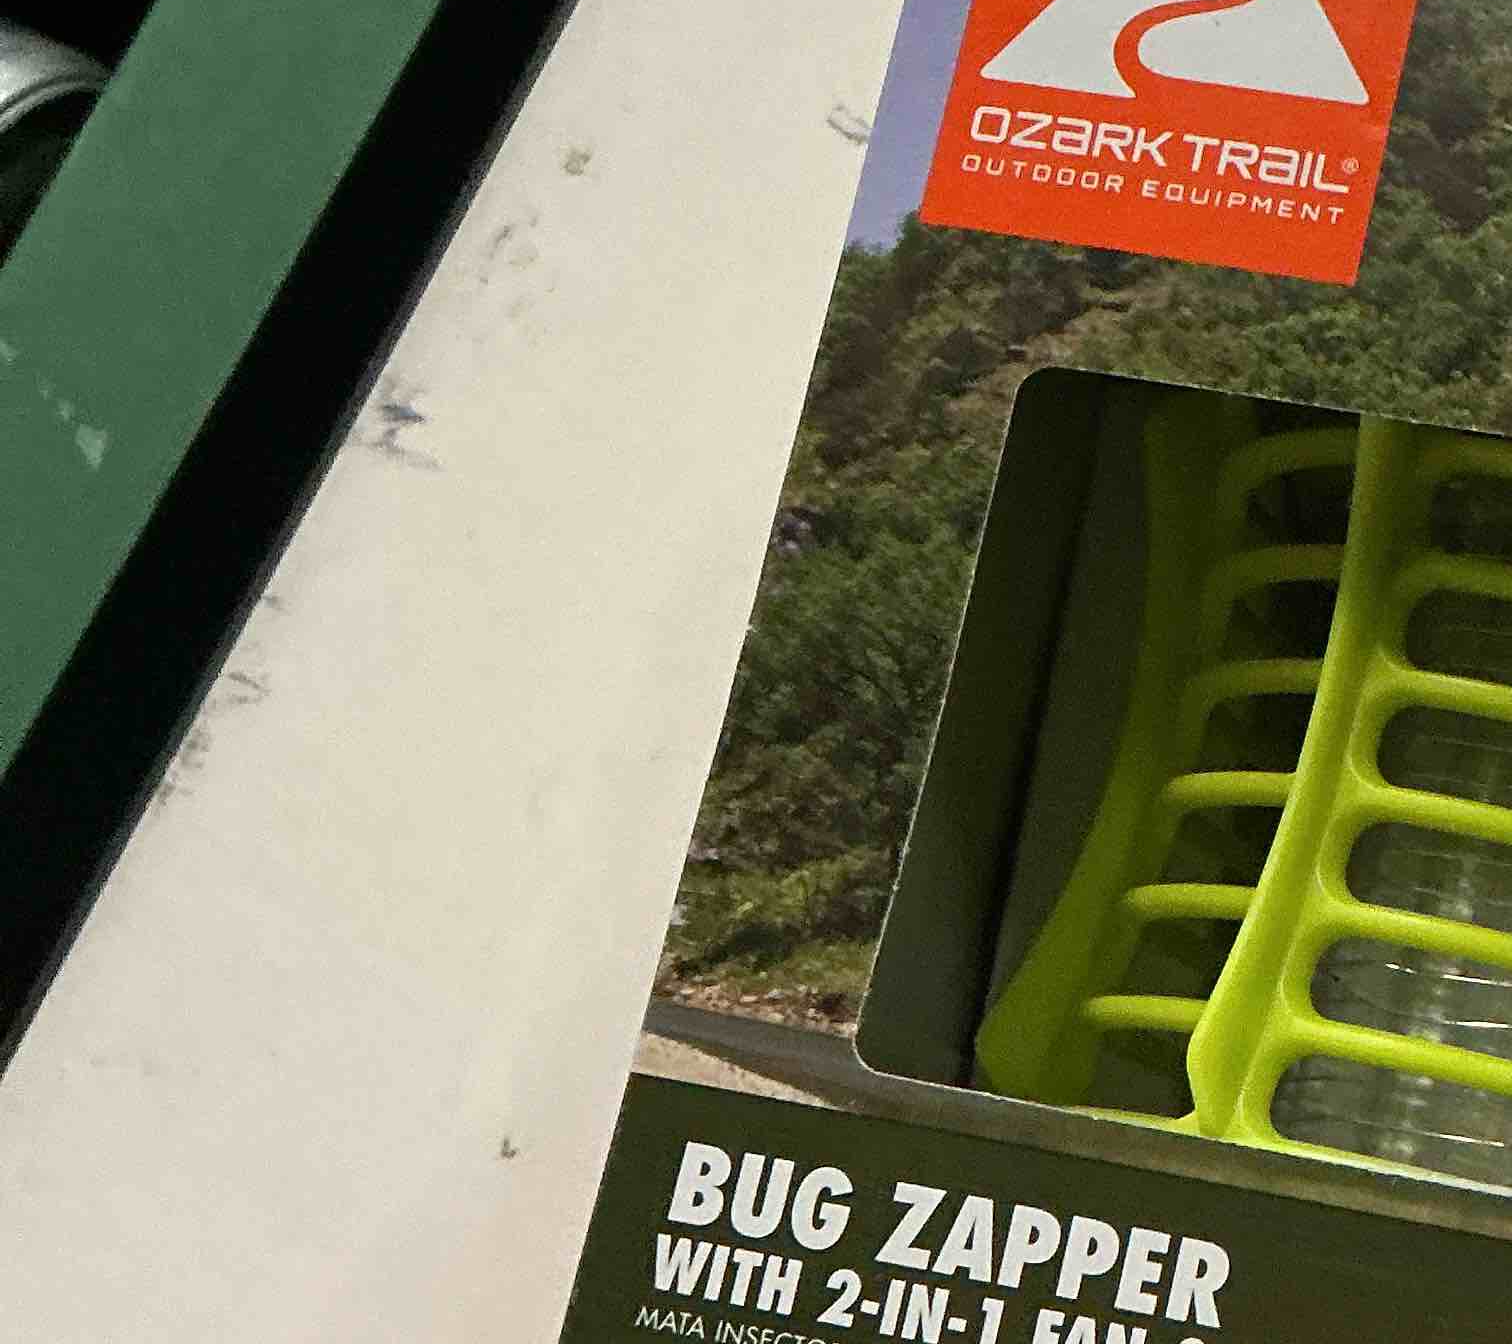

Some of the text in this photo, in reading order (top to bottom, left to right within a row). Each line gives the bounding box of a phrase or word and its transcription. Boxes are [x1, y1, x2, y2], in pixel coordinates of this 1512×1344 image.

[960, 153, 1345, 225] OUTDOOR EQUIPMENT
[667, 1140, 1231, 1329] BUG ZAPPER
[654, 1232, 803, 1317] WITH
[634, 1306, 705, 1339] MATA
